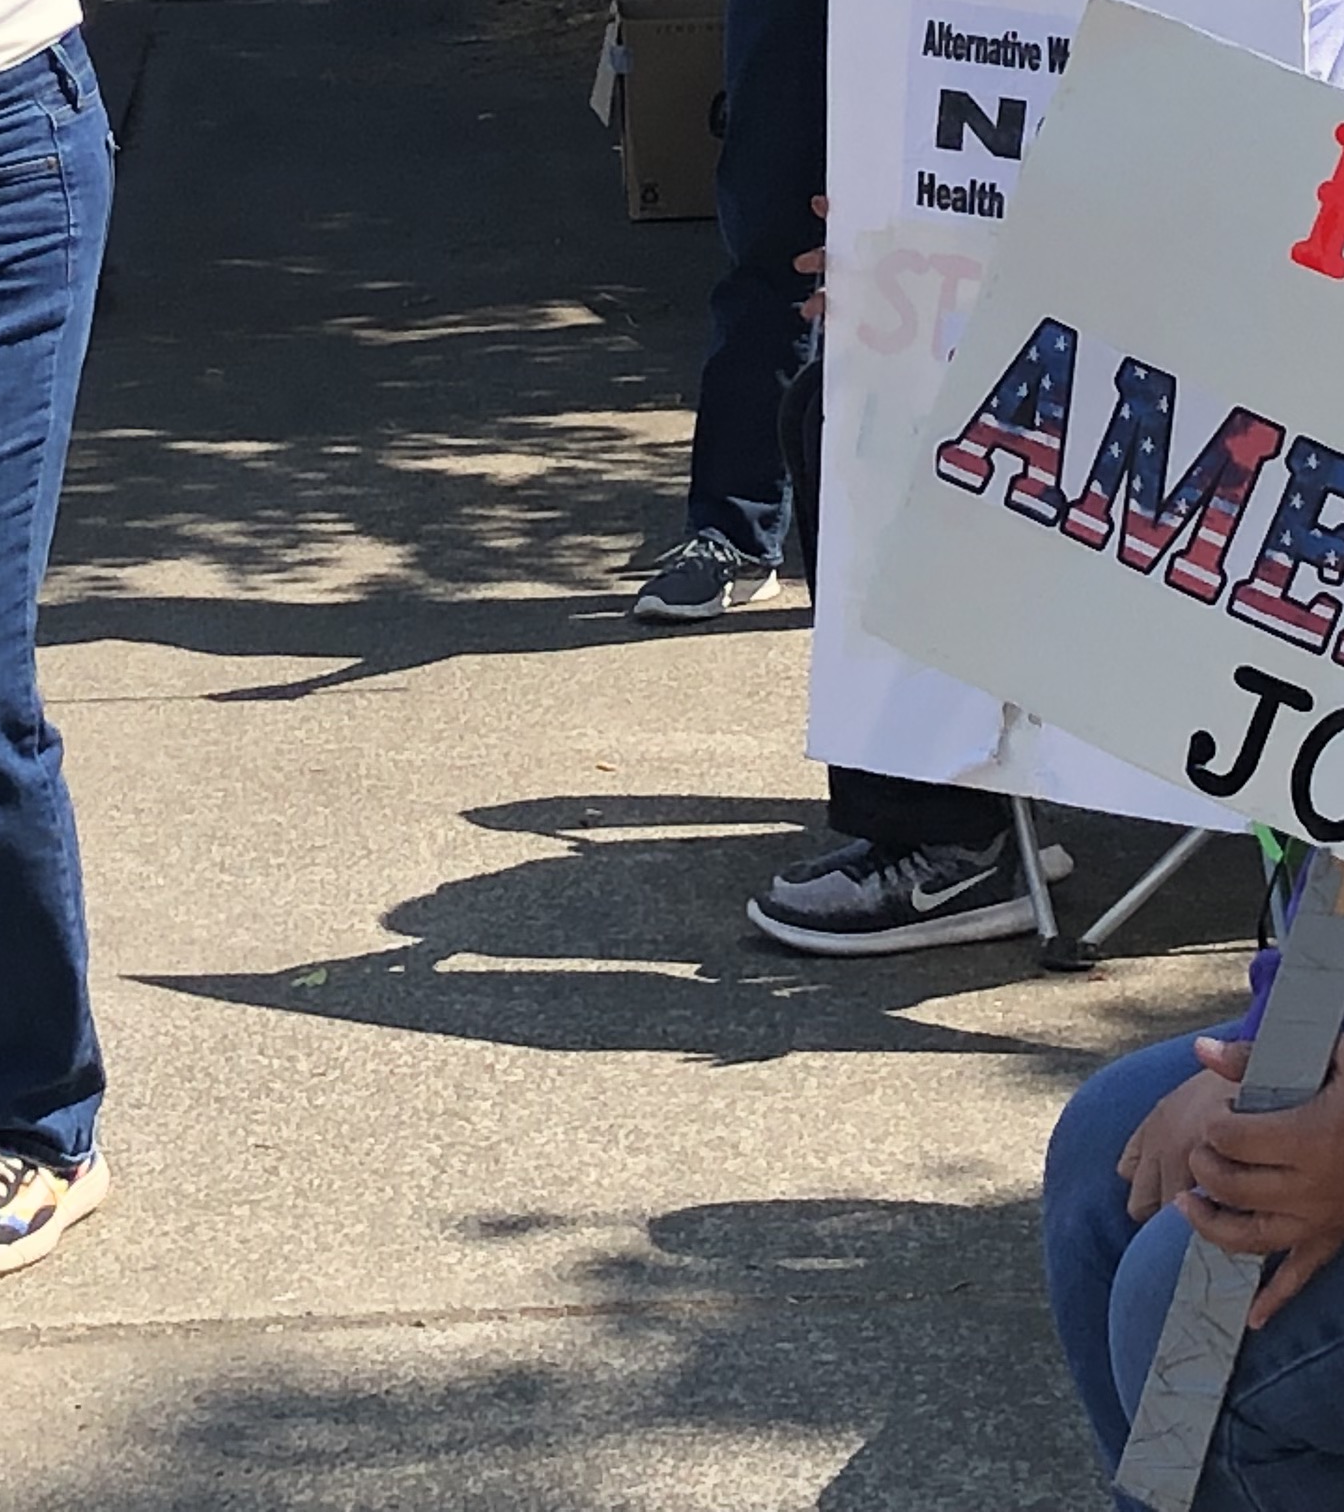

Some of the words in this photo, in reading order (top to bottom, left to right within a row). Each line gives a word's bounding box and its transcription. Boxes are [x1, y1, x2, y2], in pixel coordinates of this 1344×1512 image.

[922, 19, 1042, 72] Alternative
[1046, 35, 1071, 76] W
[935, 88, 1044, 162] N
[916, 170, 1006, 220] Health
